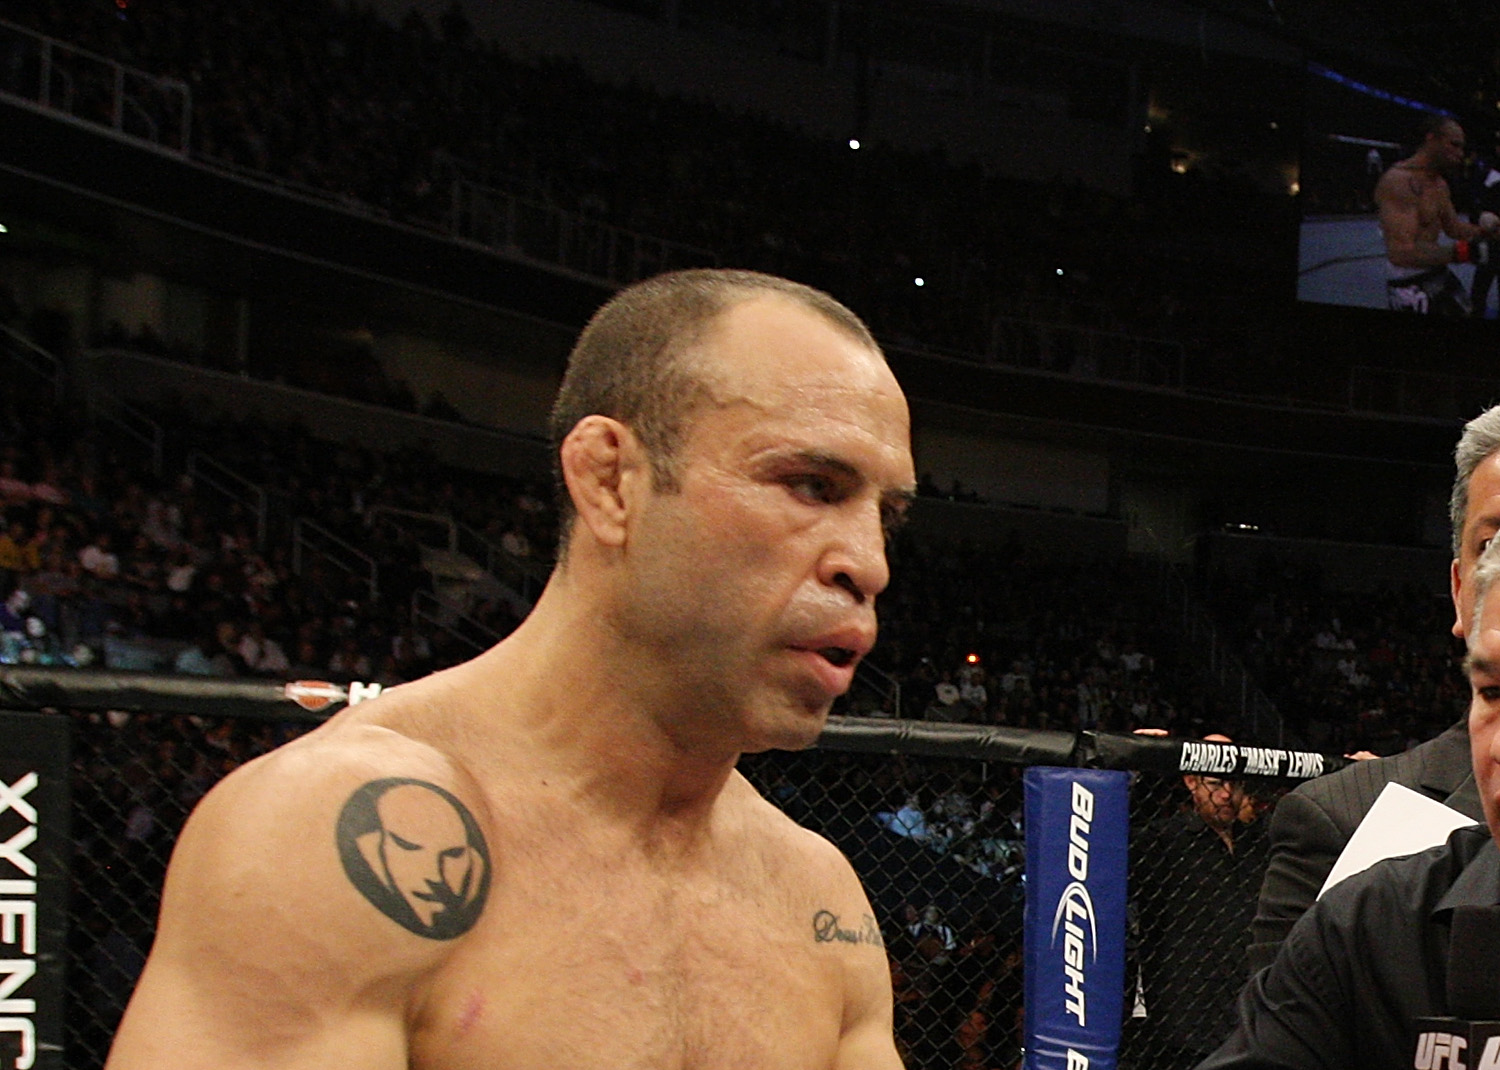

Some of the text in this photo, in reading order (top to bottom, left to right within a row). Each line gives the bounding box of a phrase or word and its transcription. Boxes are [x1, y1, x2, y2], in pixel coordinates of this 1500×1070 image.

[1179, 741, 1324, 777] CHARLES "MASK" LEWIS
[1063, 781, 1094, 1027] BUD LIGHT
